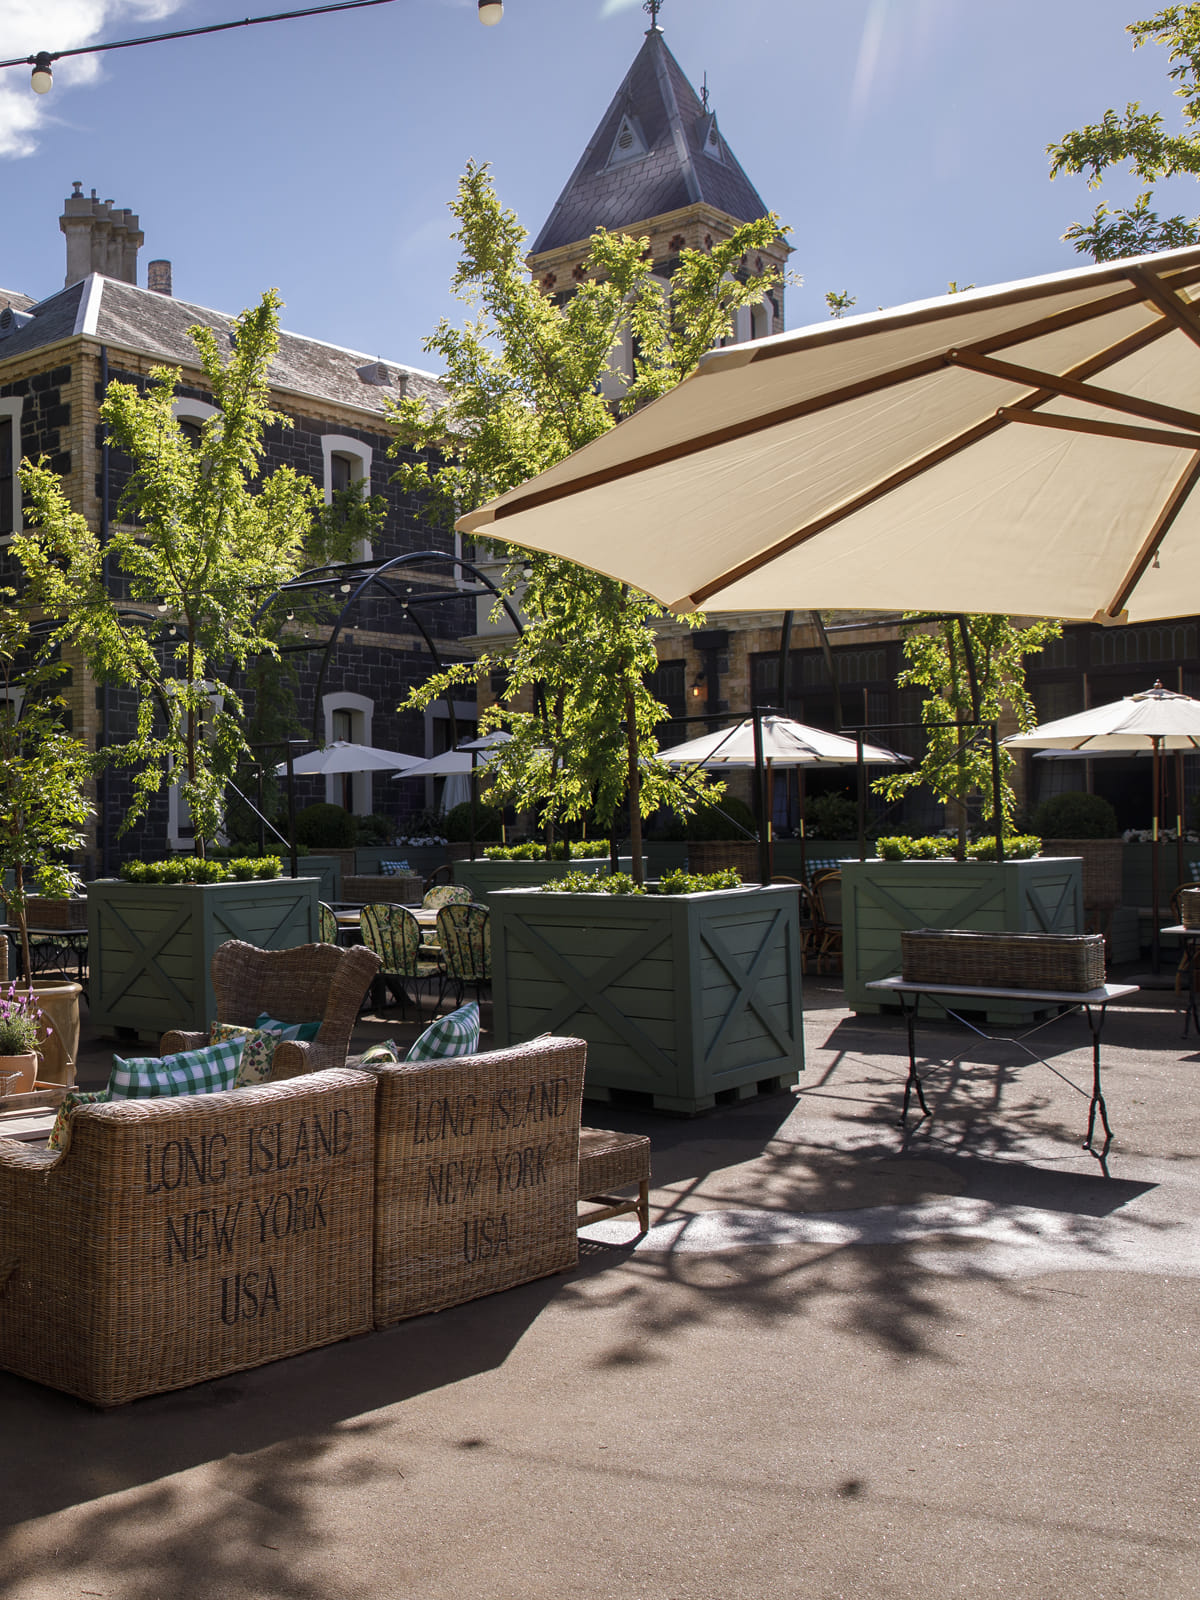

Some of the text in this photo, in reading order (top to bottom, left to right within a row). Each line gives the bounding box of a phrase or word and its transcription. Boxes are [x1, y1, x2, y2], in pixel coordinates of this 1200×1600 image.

[414, 1078, 569, 1144] LONG ISLAND
[144, 1109, 352, 1194] LONG ISLAND
[427, 1142, 552, 1207] NEW YORK
[167, 1181, 328, 1266] NEW YORK
[463, 1212, 509, 1263] USA
[221, 1266, 280, 1325] USA
